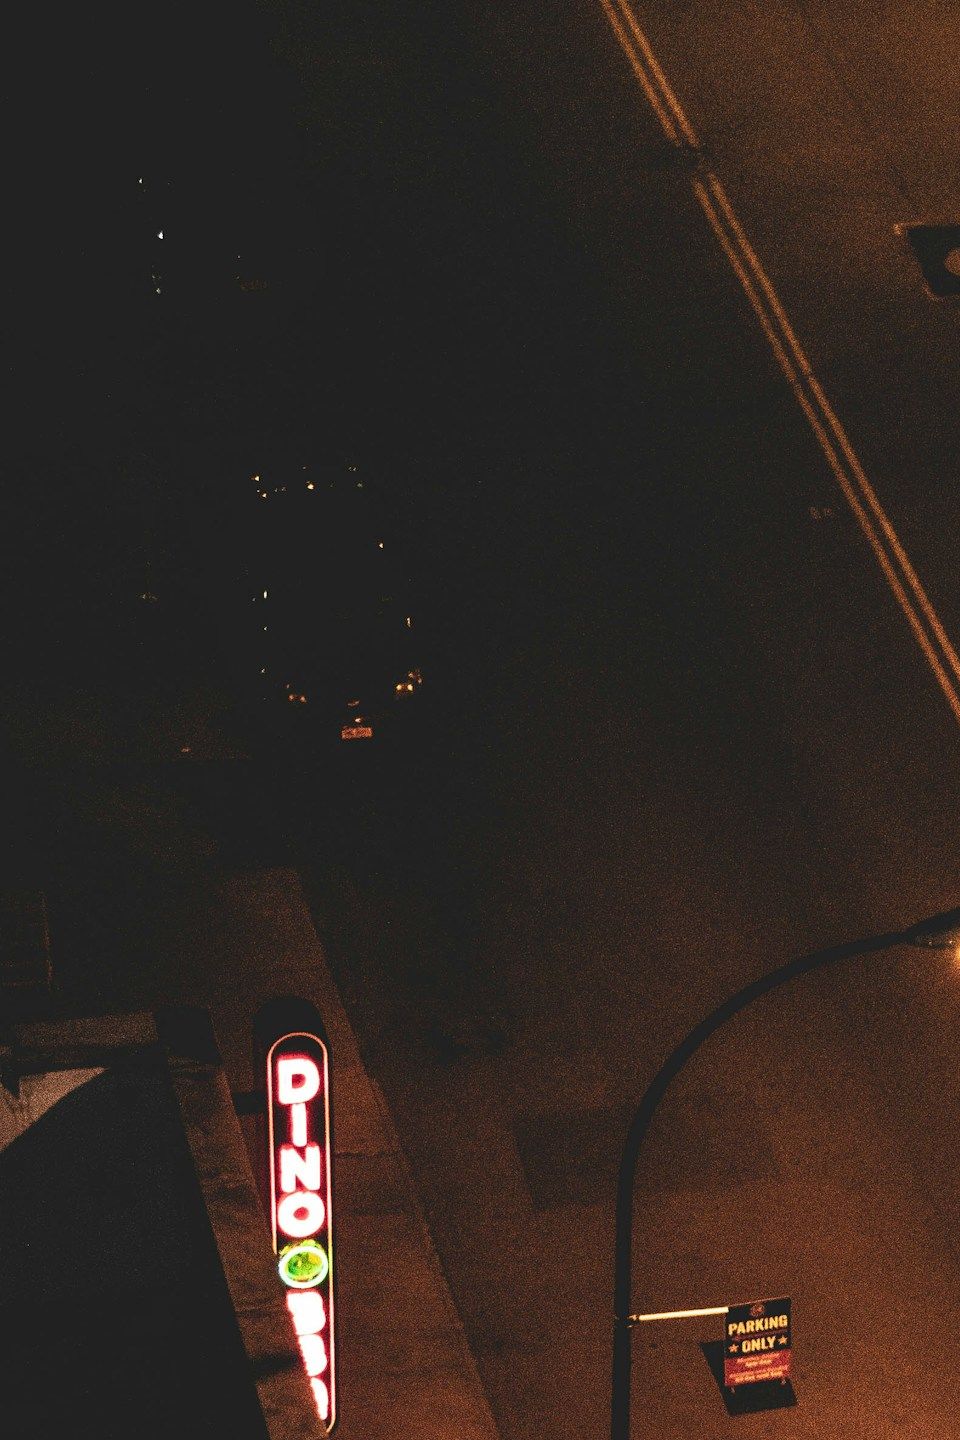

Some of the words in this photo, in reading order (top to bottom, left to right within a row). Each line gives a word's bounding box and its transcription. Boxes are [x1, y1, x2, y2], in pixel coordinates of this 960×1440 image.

[277, 1057, 325, 1238] DINO
[729, 1315, 788, 1335] PARKING
[741, 1336, 776, 1353] ONLY
